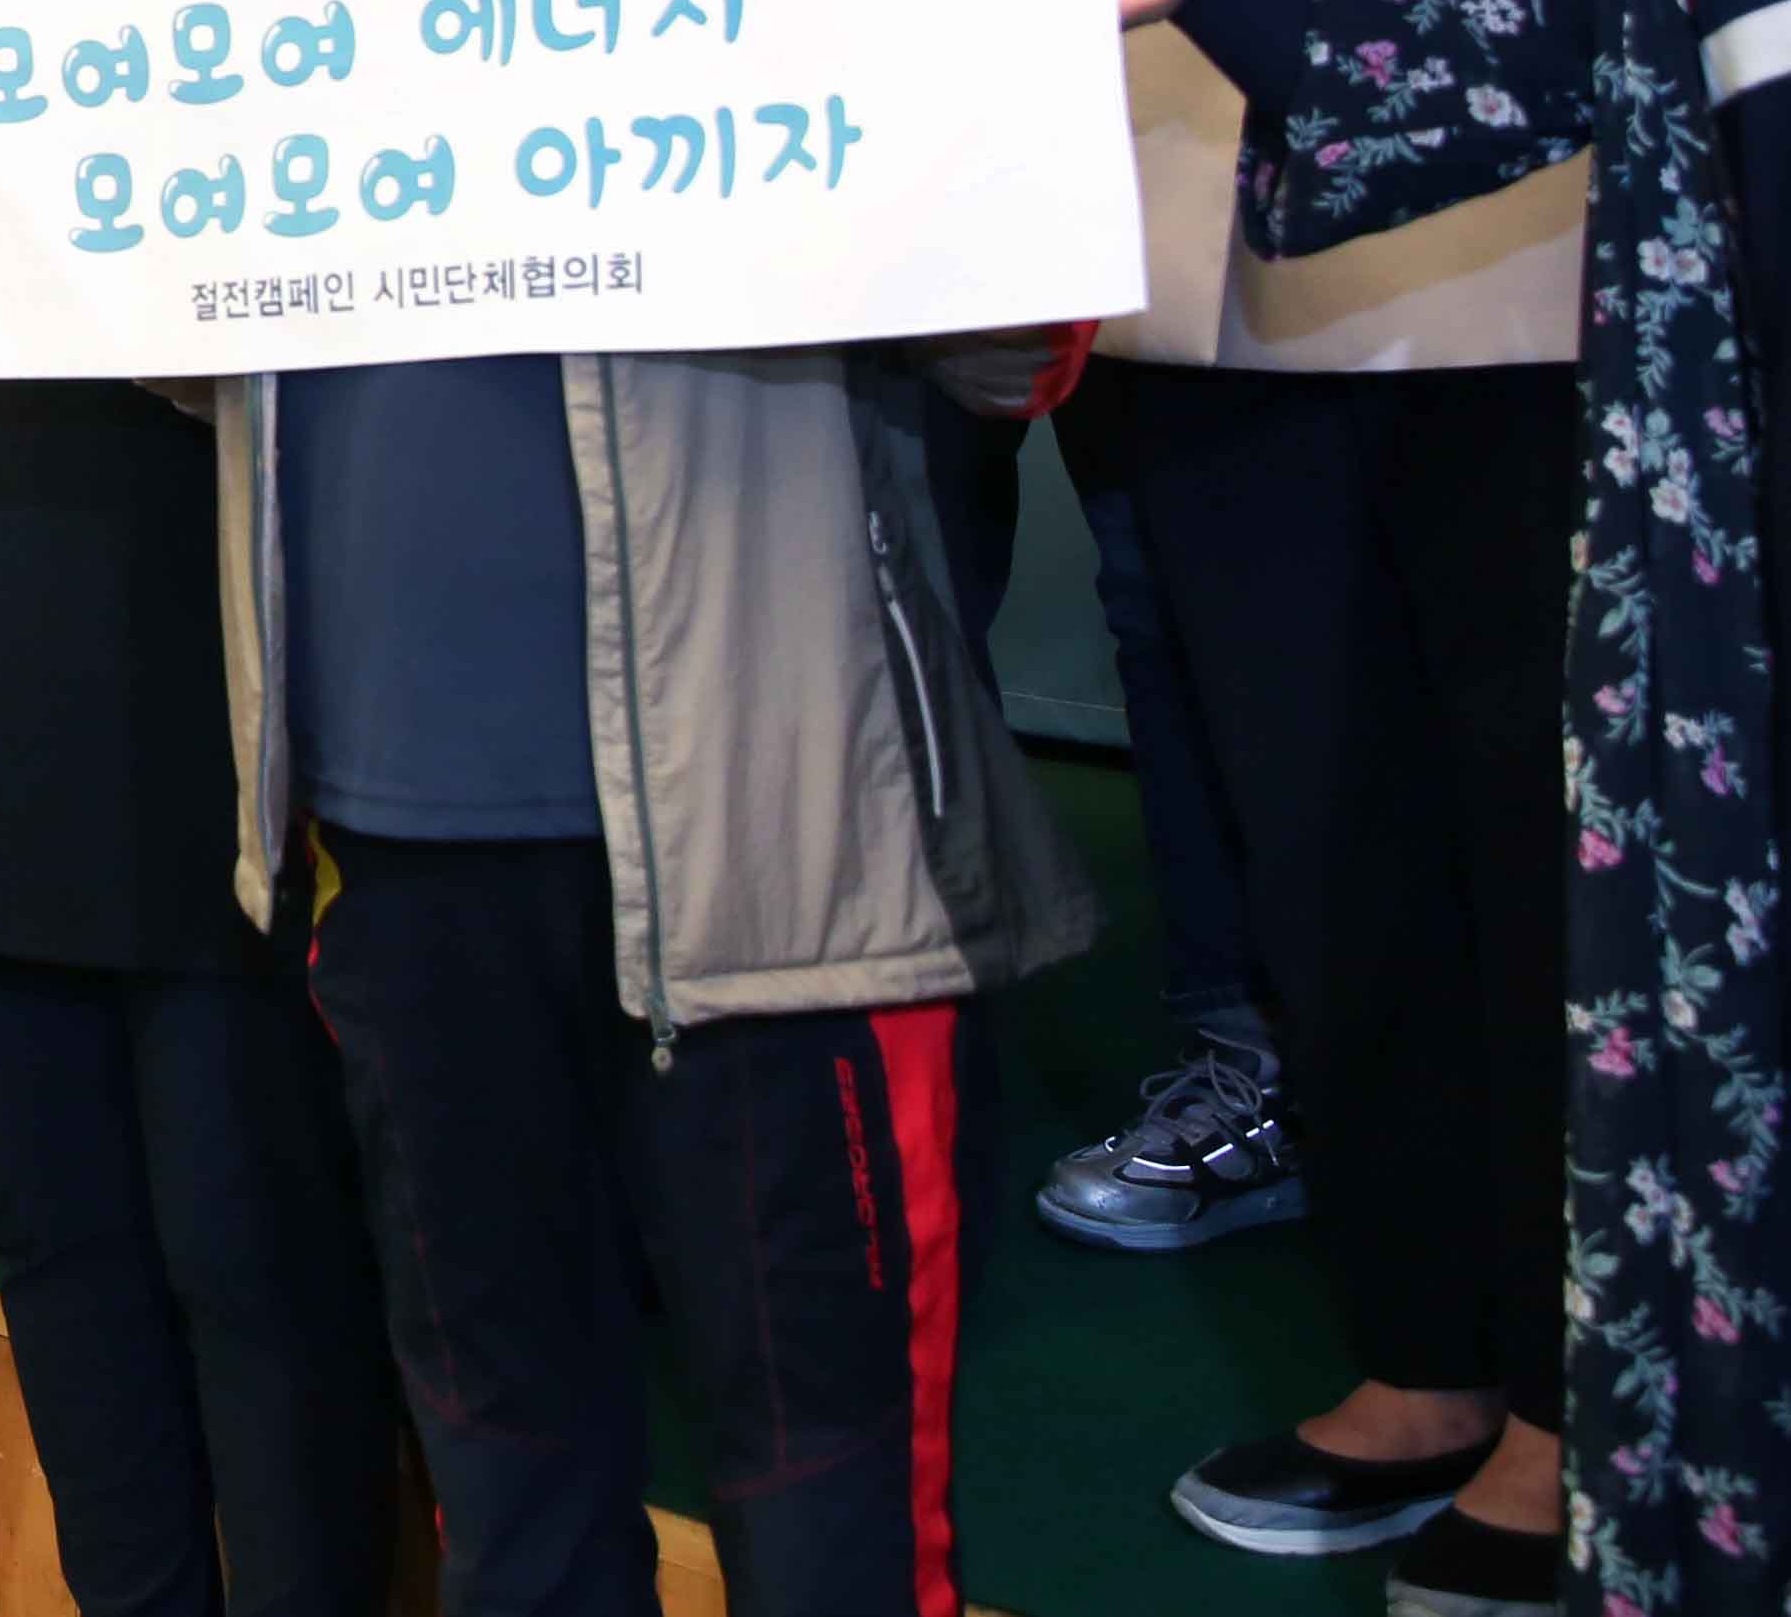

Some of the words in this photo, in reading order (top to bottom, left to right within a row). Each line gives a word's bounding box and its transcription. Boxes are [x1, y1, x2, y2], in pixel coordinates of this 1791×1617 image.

[71, 134, 456, 253] 모여모여
[515, 95, 863, 208] 아끼자
[192, 271, 354, 321] 절전캠페인
[374, 252, 642, 309] 시민단체협의회
